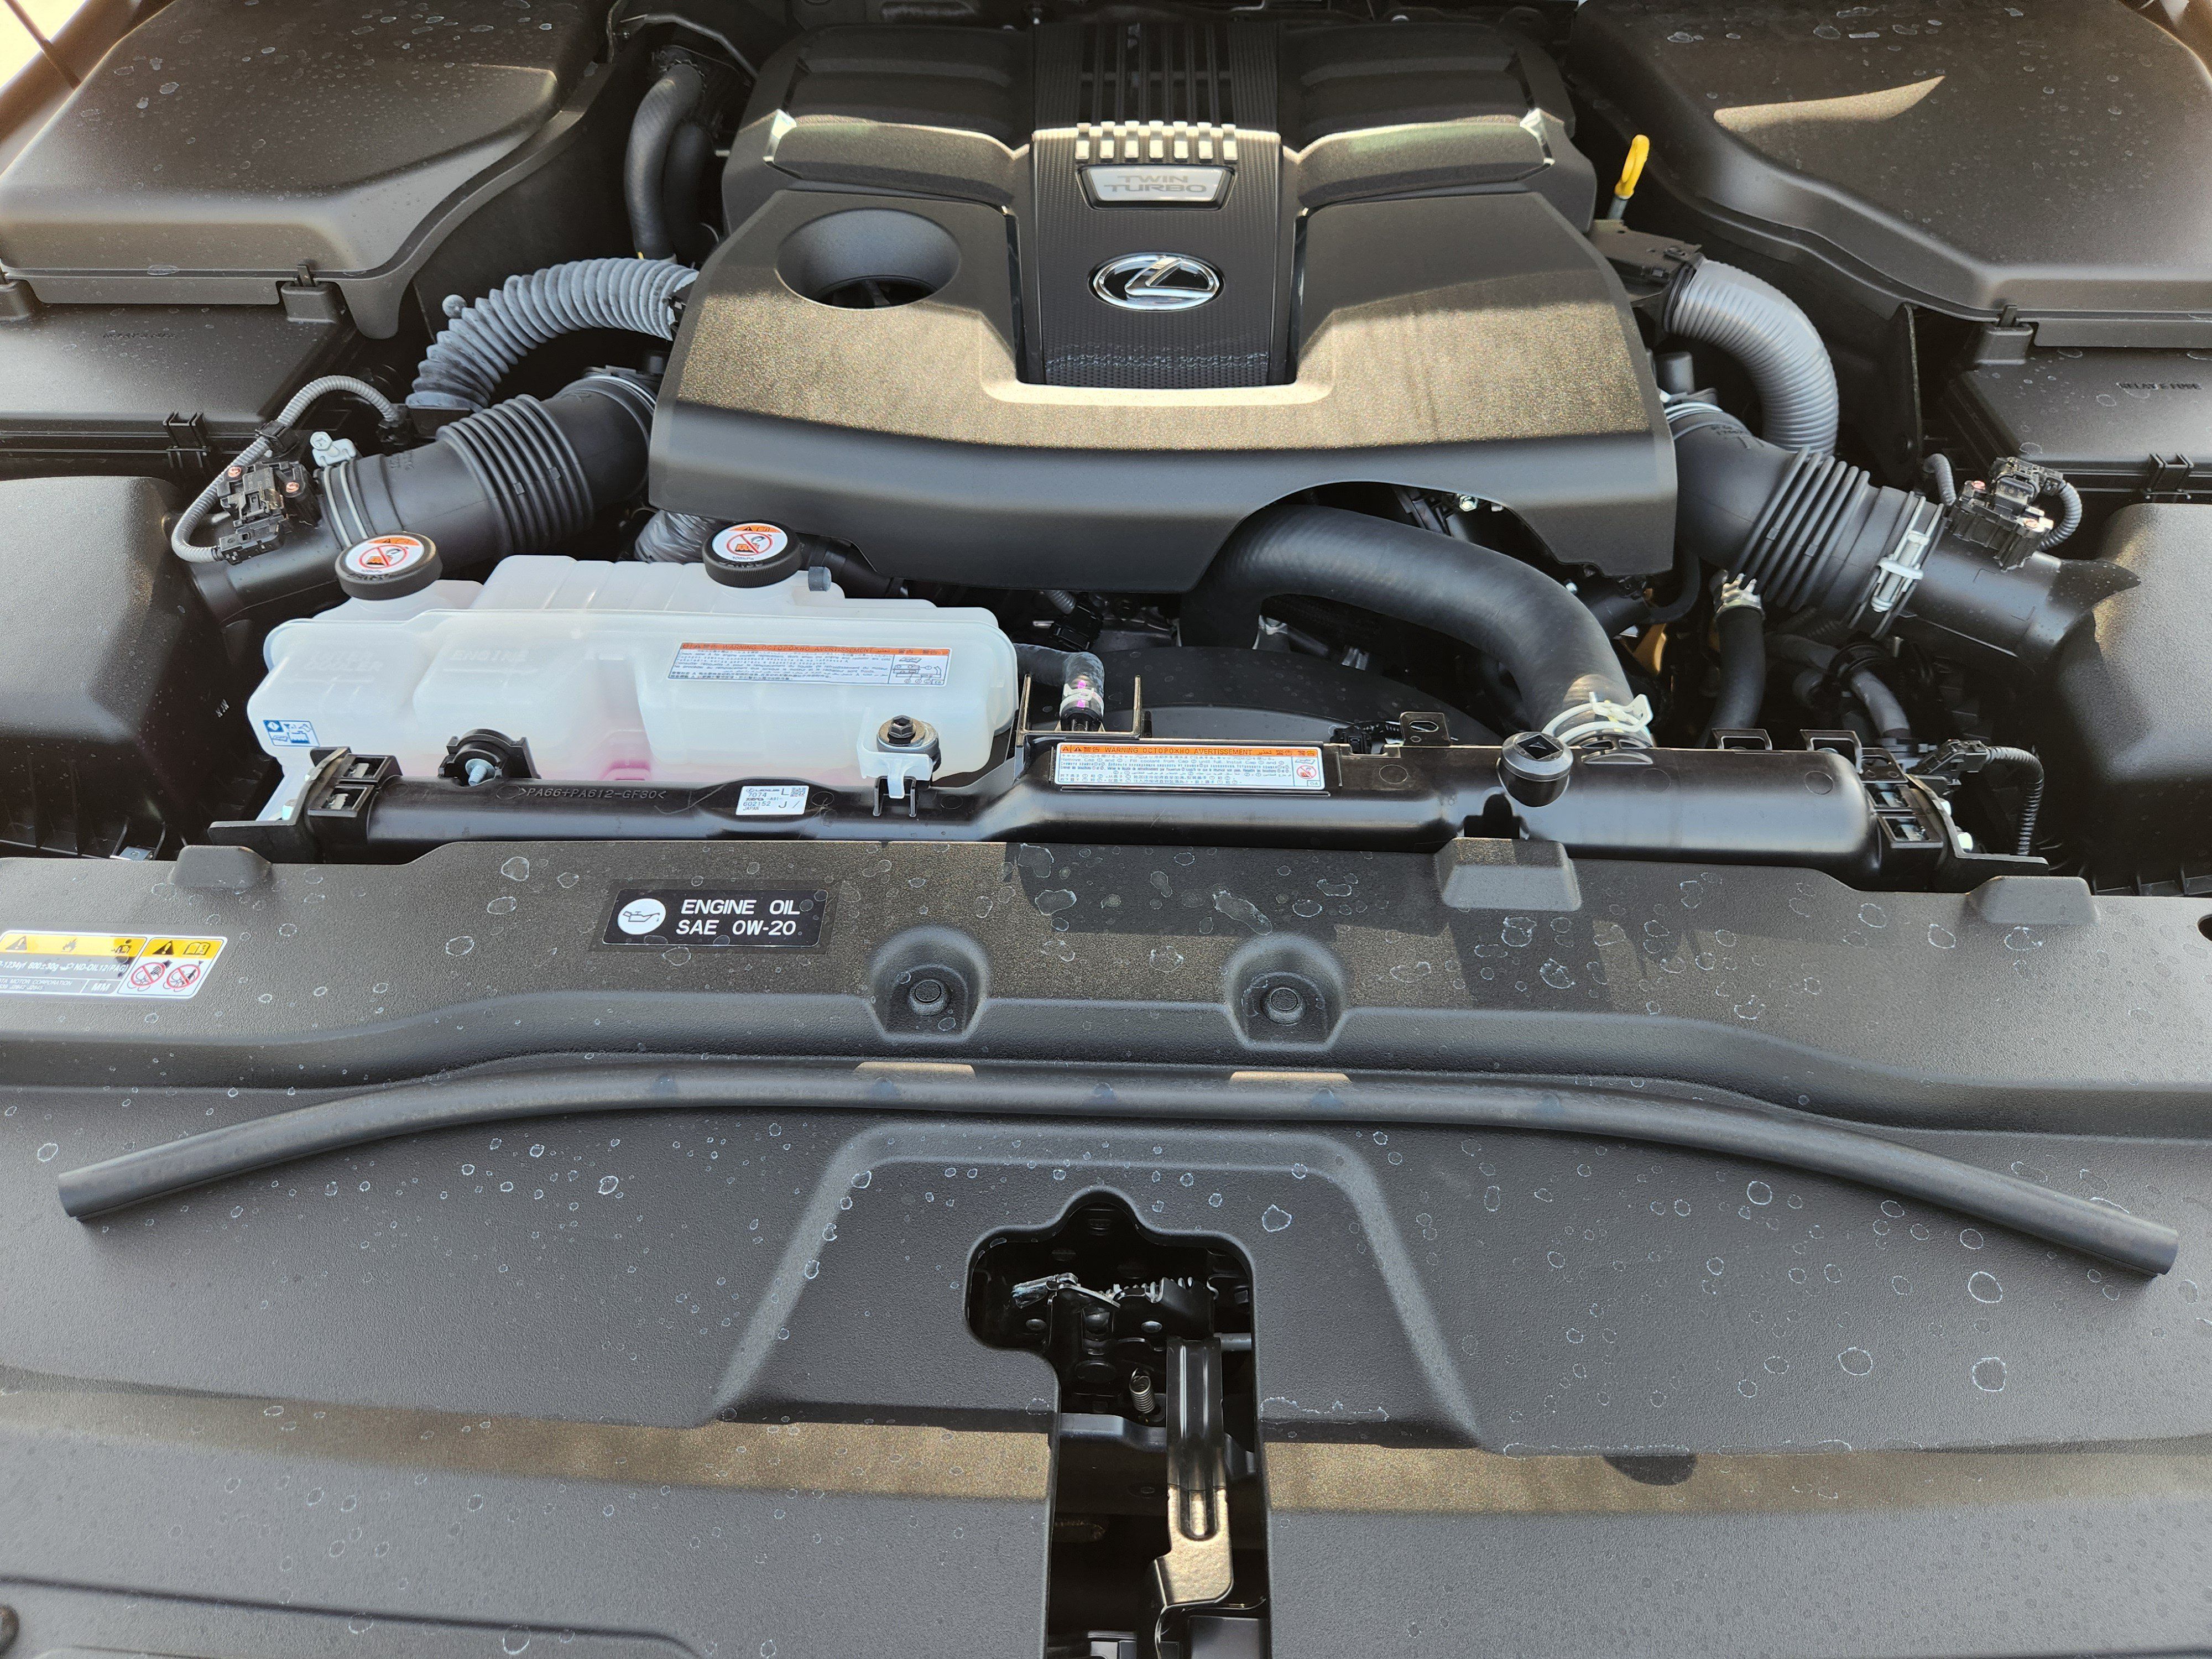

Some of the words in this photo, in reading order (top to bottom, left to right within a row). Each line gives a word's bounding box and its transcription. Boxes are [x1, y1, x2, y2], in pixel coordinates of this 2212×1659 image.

[1117, 175, 1188, 183] TWIN
[1104, 184, 1207, 192] TURBO
[451, 649, 529, 661] ENGINE
[681, 899, 757, 915] ENGINE
[769, 899, 801, 915] OIL
[676, 919, 719, 936] SAE
[732, 920, 796, 936] 0W-20
[91, 983, 112, 992] MM
